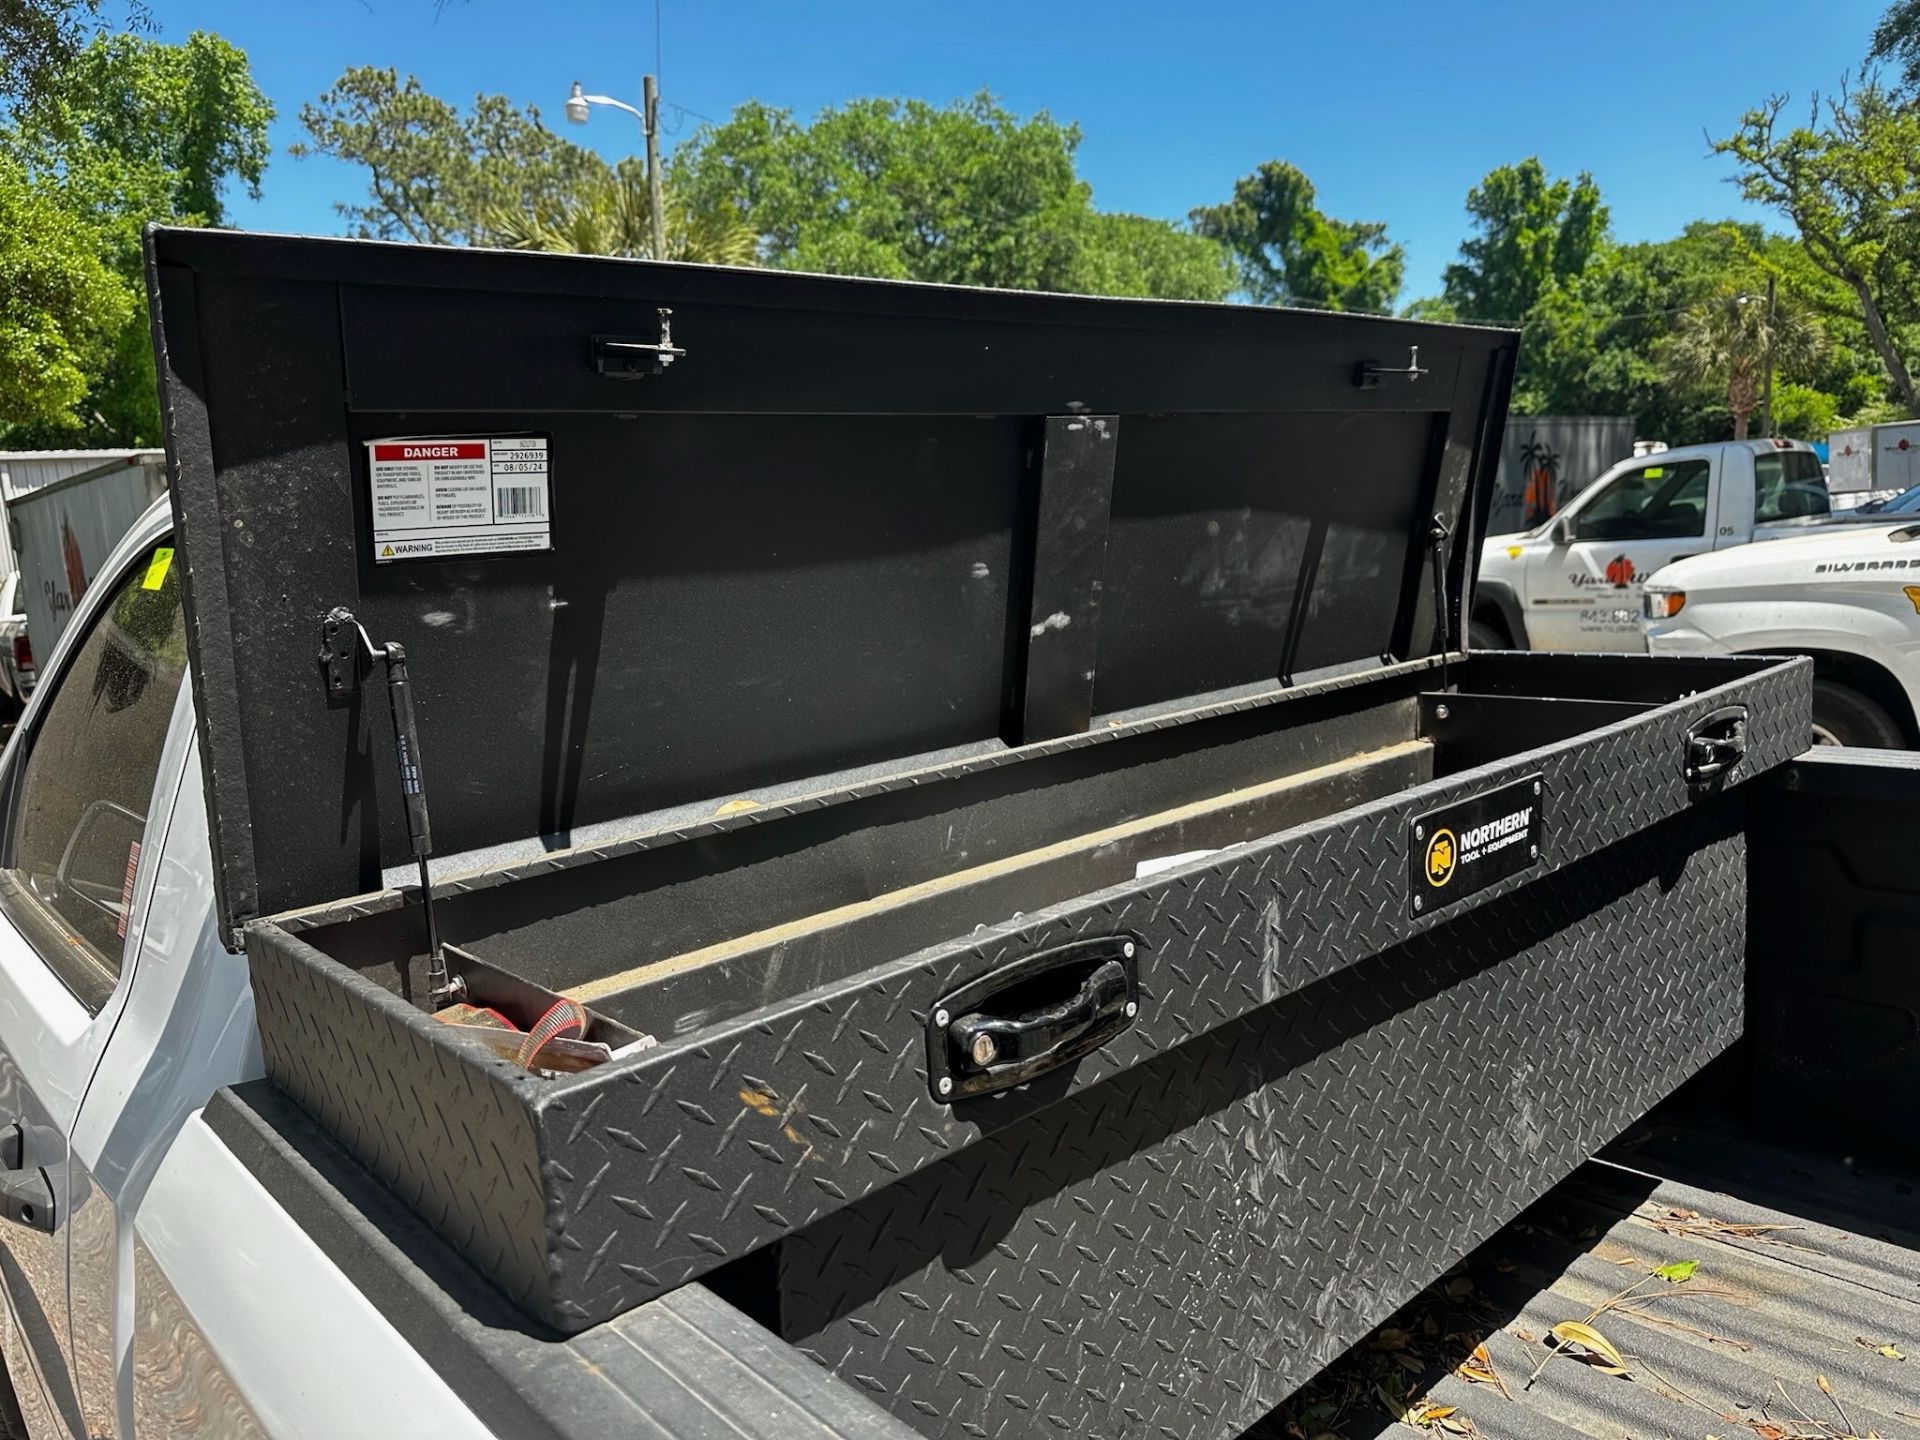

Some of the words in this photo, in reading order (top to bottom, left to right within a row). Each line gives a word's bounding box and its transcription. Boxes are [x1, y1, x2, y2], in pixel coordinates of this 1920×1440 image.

[404, 447, 458, 458] DANGER
[510, 452, 543, 460] 2926939
[504, 463, 542, 471] 08/05/24
[1719, 526, 1734, 536] 05
[395, 543, 433, 553] WARNING
[1460, 809, 1531, 852] NORTHERN
[1460, 850, 1481, 865] TOOL
[1487, 828, 1529, 854] EQUIPMENT
